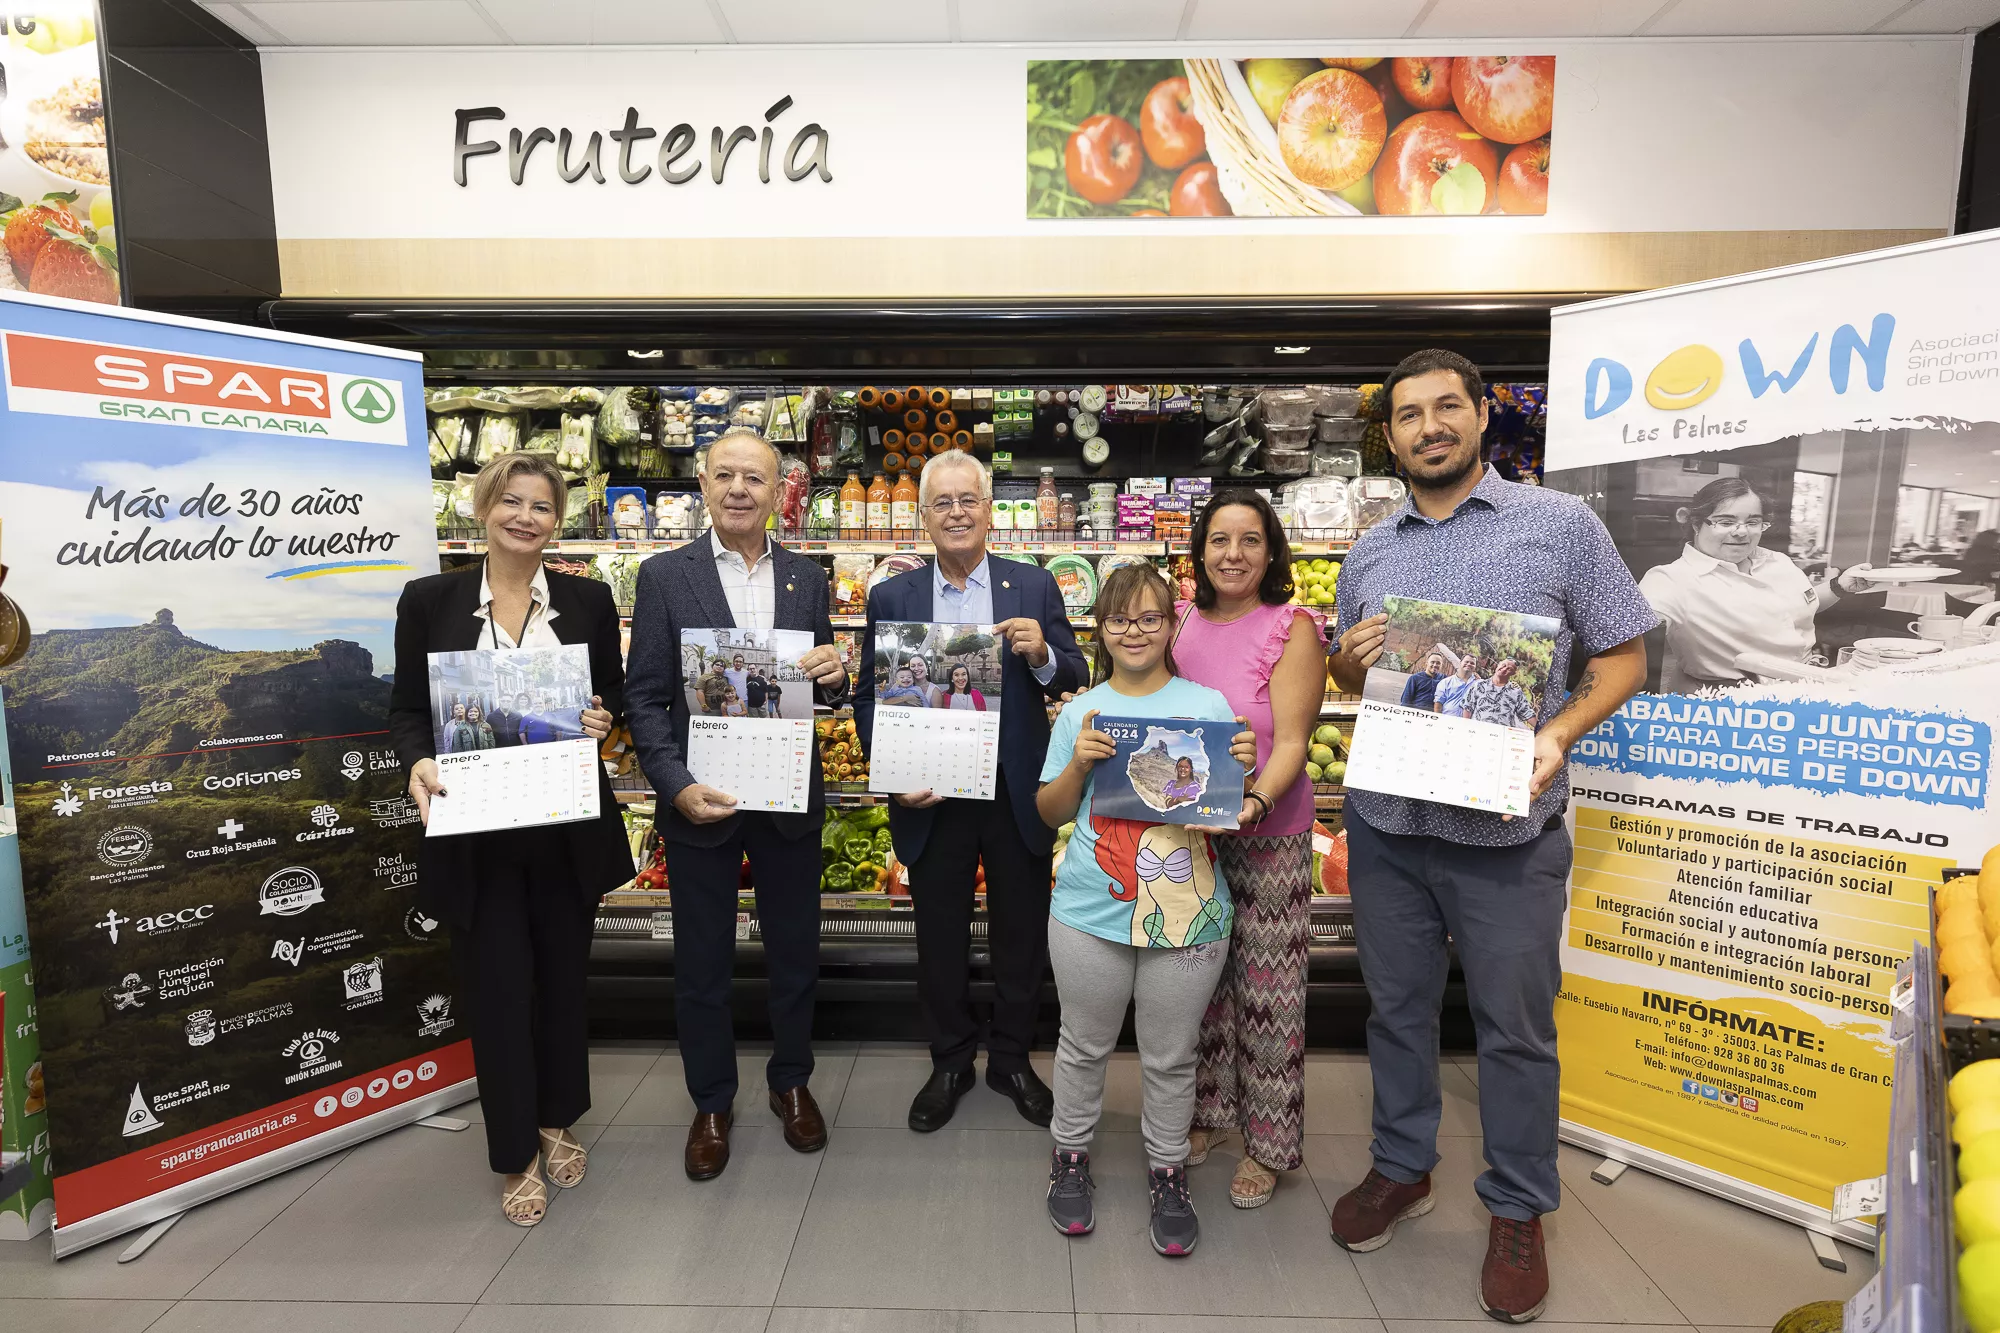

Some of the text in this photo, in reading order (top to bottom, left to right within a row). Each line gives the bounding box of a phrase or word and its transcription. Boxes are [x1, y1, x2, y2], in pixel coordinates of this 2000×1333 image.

[453, 94, 833, 187] Frutería
[1909, 328, 1999, 353] Asociaci
[1584, 312, 1896, 420] DOWN
[1907, 351, 1998, 370] Síndrom
[94, 354, 326, 410] SPAR
[1906, 367, 1999, 386] de Down
[99, 401, 329, 435] GRAN CANARIA
[1622, 414, 1748, 445] Las Palmas
[85, 482, 363, 521] Más de 30 años
[56, 524, 400, 567] cuidando lo nuestro
[1060, 573, 1075, 581] PASTA
[878, 709, 911, 719] marzo
[1364, 702, 1440, 721] noviembre
[1611, 700, 1796, 733] ABAJANDO
[1807, 713, 1975, 747] JUNTOS
[692, 719, 729, 730] febrero
[1103, 721, 1139, 729] CALENDARIO
[1103, 727, 1139, 739] 2024
[199, 732, 283, 747] Colaboramos con
[1623, 721, 1641, 739] Y
[1648, 725, 1722, 751] PARA
[1731, 731, 1787, 754] LAS
[1797, 736, 1982, 773] PERSONAS
[47, 749, 116, 763] Patronos de
[369, 751, 382, 760] EL
[441, 753, 482, 765] enero
[1628, 740, 1790, 778] SÍNDROME
[1802, 761, 1846, 785] DE
[1859, 766, 1981, 798] DOWN
[88, 780, 173, 801] Foresta
[1571, 786, 1949, 848] PROGRAMAS DE TRABAJO
[110, 834, 140, 843] FESBAL
[295, 826, 355, 843] Cáritas
[1609, 815, 1907, 874] Gestión y promoción de la asociación
[186, 837, 277, 859] Cruz Roja Española
[378, 853, 402, 867] Red
[90, 872, 115, 881] Banco
[127, 864, 165, 875] Alimentos
[122, 873, 149, 882] Palmas
[1617, 837, 1893, 896] Voluntariado y participación social
[269, 883, 313, 897] COLABORADOR
[271, 875, 308, 891] SOCIO
[1676, 868, 1813, 905] Atención familiar
[136, 904, 214, 932] aecc
[1668, 888, 1818, 930] Atención educativa
[313, 928, 357, 943] Asociación
[1596, 895, 1827, 956] Integración social y autonomía
[2, 933, 24, 949] La
[307, 933, 364, 952] Oportunidades
[322, 943, 351, 955] de Vida
[1621, 921, 1871, 988] Formación e integración laboral
[158, 957, 224, 980] Fundación
[158, 968, 211, 990] Júnguel
[1585, 933, 1653, 962] Desarrollo
[1657, 951, 1665, 966] y
[1669, 955, 1784, 992] mantenimiento
[1789, 981, 1893, 1017] socio-perso
[159, 980, 215, 1000] Sanjuán
[362, 990, 383, 1000] ISLAS
[220, 1002, 293, 1026] UNIÓN DEPORTIVA
[346, 996, 384, 1011] CANARIAS
[221, 1008, 294, 1034] LAS PALMAS
[1642, 990, 1825, 1053] INFÓRMATE:
[281, 1028, 341, 1057] Club de Lucha
[1556, 989, 1581, 1004] Calle:
[1584, 996, 1619, 1015] Eusebio
[1621, 1006, 1662, 1028] Navarro,
[1665, 1019, 1676, 1029] nº
[1679, 1023, 1691, 1034] 69
[1723, 1033, 1759, 1053] 35003.
[1763, 1043, 1782, 1058] Las
[1785, 1051, 1827, 1071] Palmas
[1830, 1062, 1845, 1075] de
[1849, 1066, 1878, 1084] Gran
[1664, 1032, 1785, 1074] Teléfono: 928 36 80 36
[285, 1059, 343, 1085] UNIÓN SARDINA
[1635, 1038, 1817, 1099] E-mail: info@downlaspalmas.com
[153, 1080, 209, 1103] Bote SPAR
[1643, 1055, 1804, 1111] Web: www.downlaspalmas.com
[154, 1082, 231, 1113] Guerra del Río
[1604, 1069, 1639, 1085] Asociación
[1640, 1080, 1664, 1092] creada
[1703, 1100, 1739, 1116] declarada
[1740, 1109, 1750, 1118] de
[1752, 1114, 1779, 1128] utilidad
[1780, 1122, 1808, 1137] pública
[1810, 1132, 1820, 1140] en
[1823, 1135, 1849, 1149] 1997.
[160, 1112, 297, 1170] spargrancanaria.es
